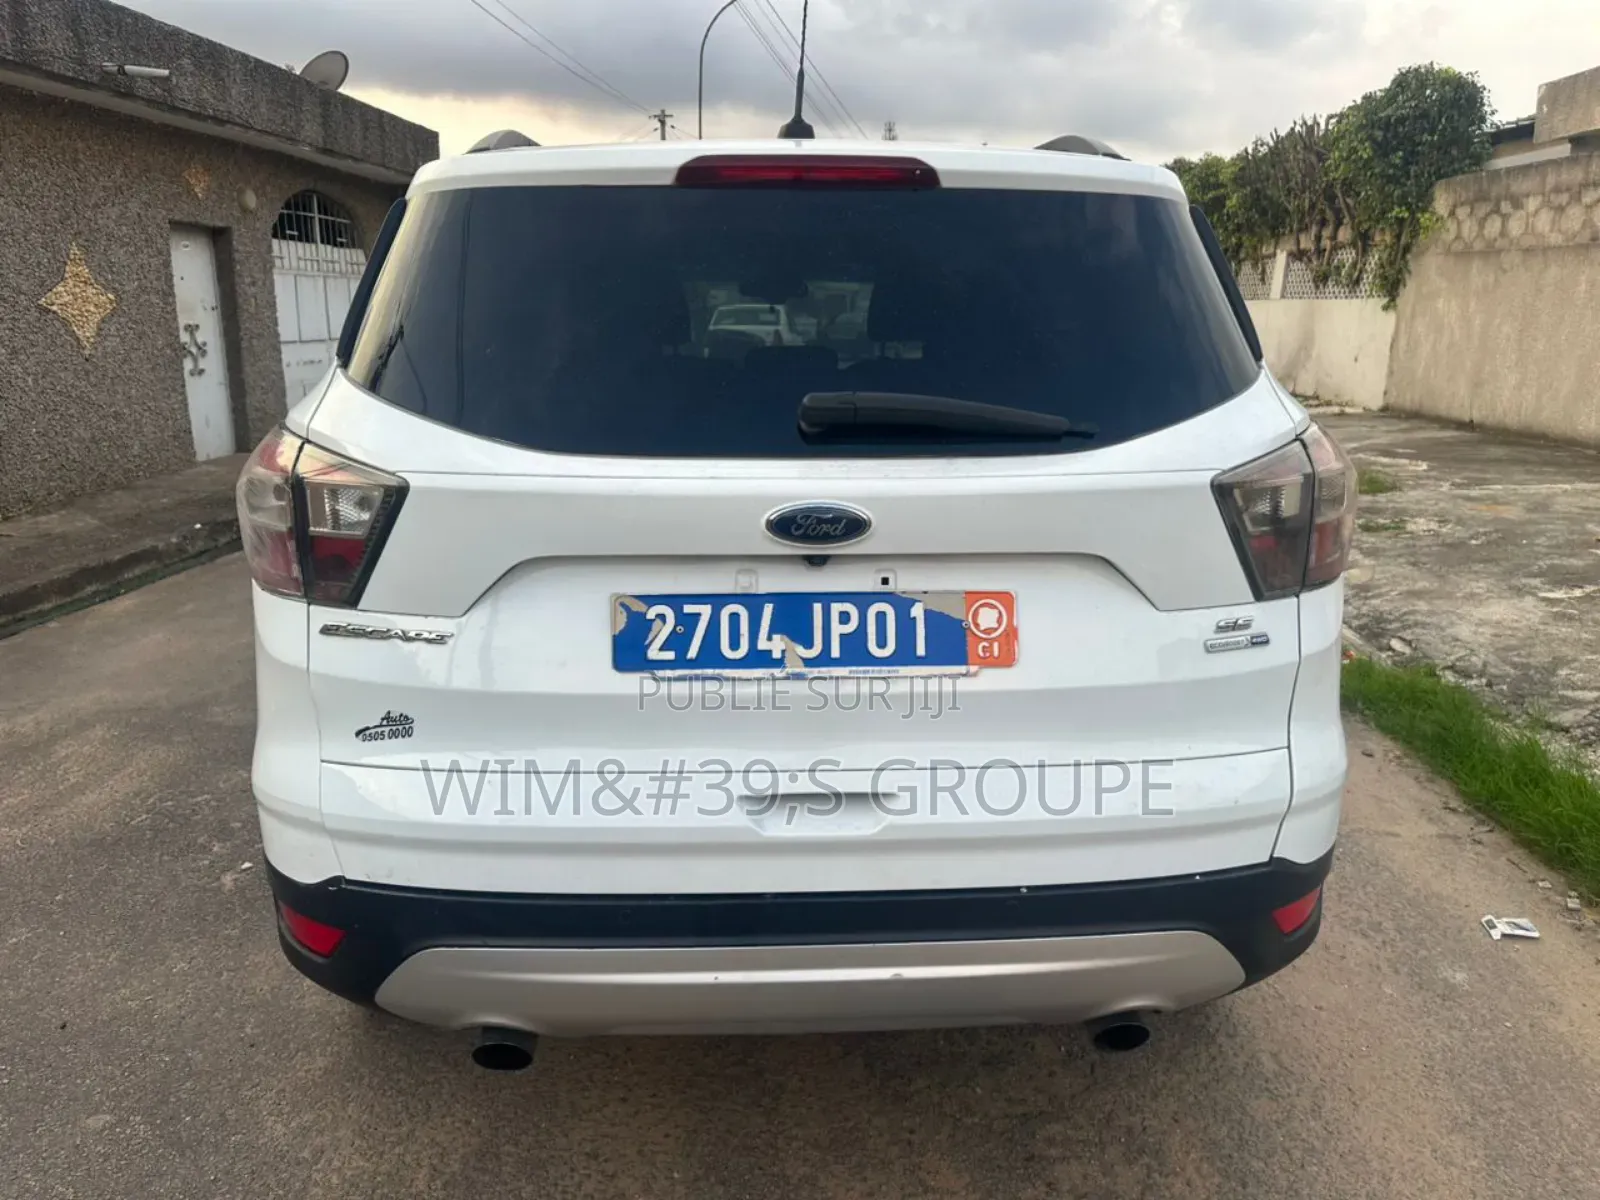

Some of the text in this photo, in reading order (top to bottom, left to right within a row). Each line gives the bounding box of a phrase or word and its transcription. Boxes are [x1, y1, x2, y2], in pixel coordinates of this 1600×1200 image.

[790, 513, 847, 537] Ford
[978, 641, 999, 658] CI
[380, 710, 414, 725] Auto
[362, 726, 414, 742] 0505 0000
